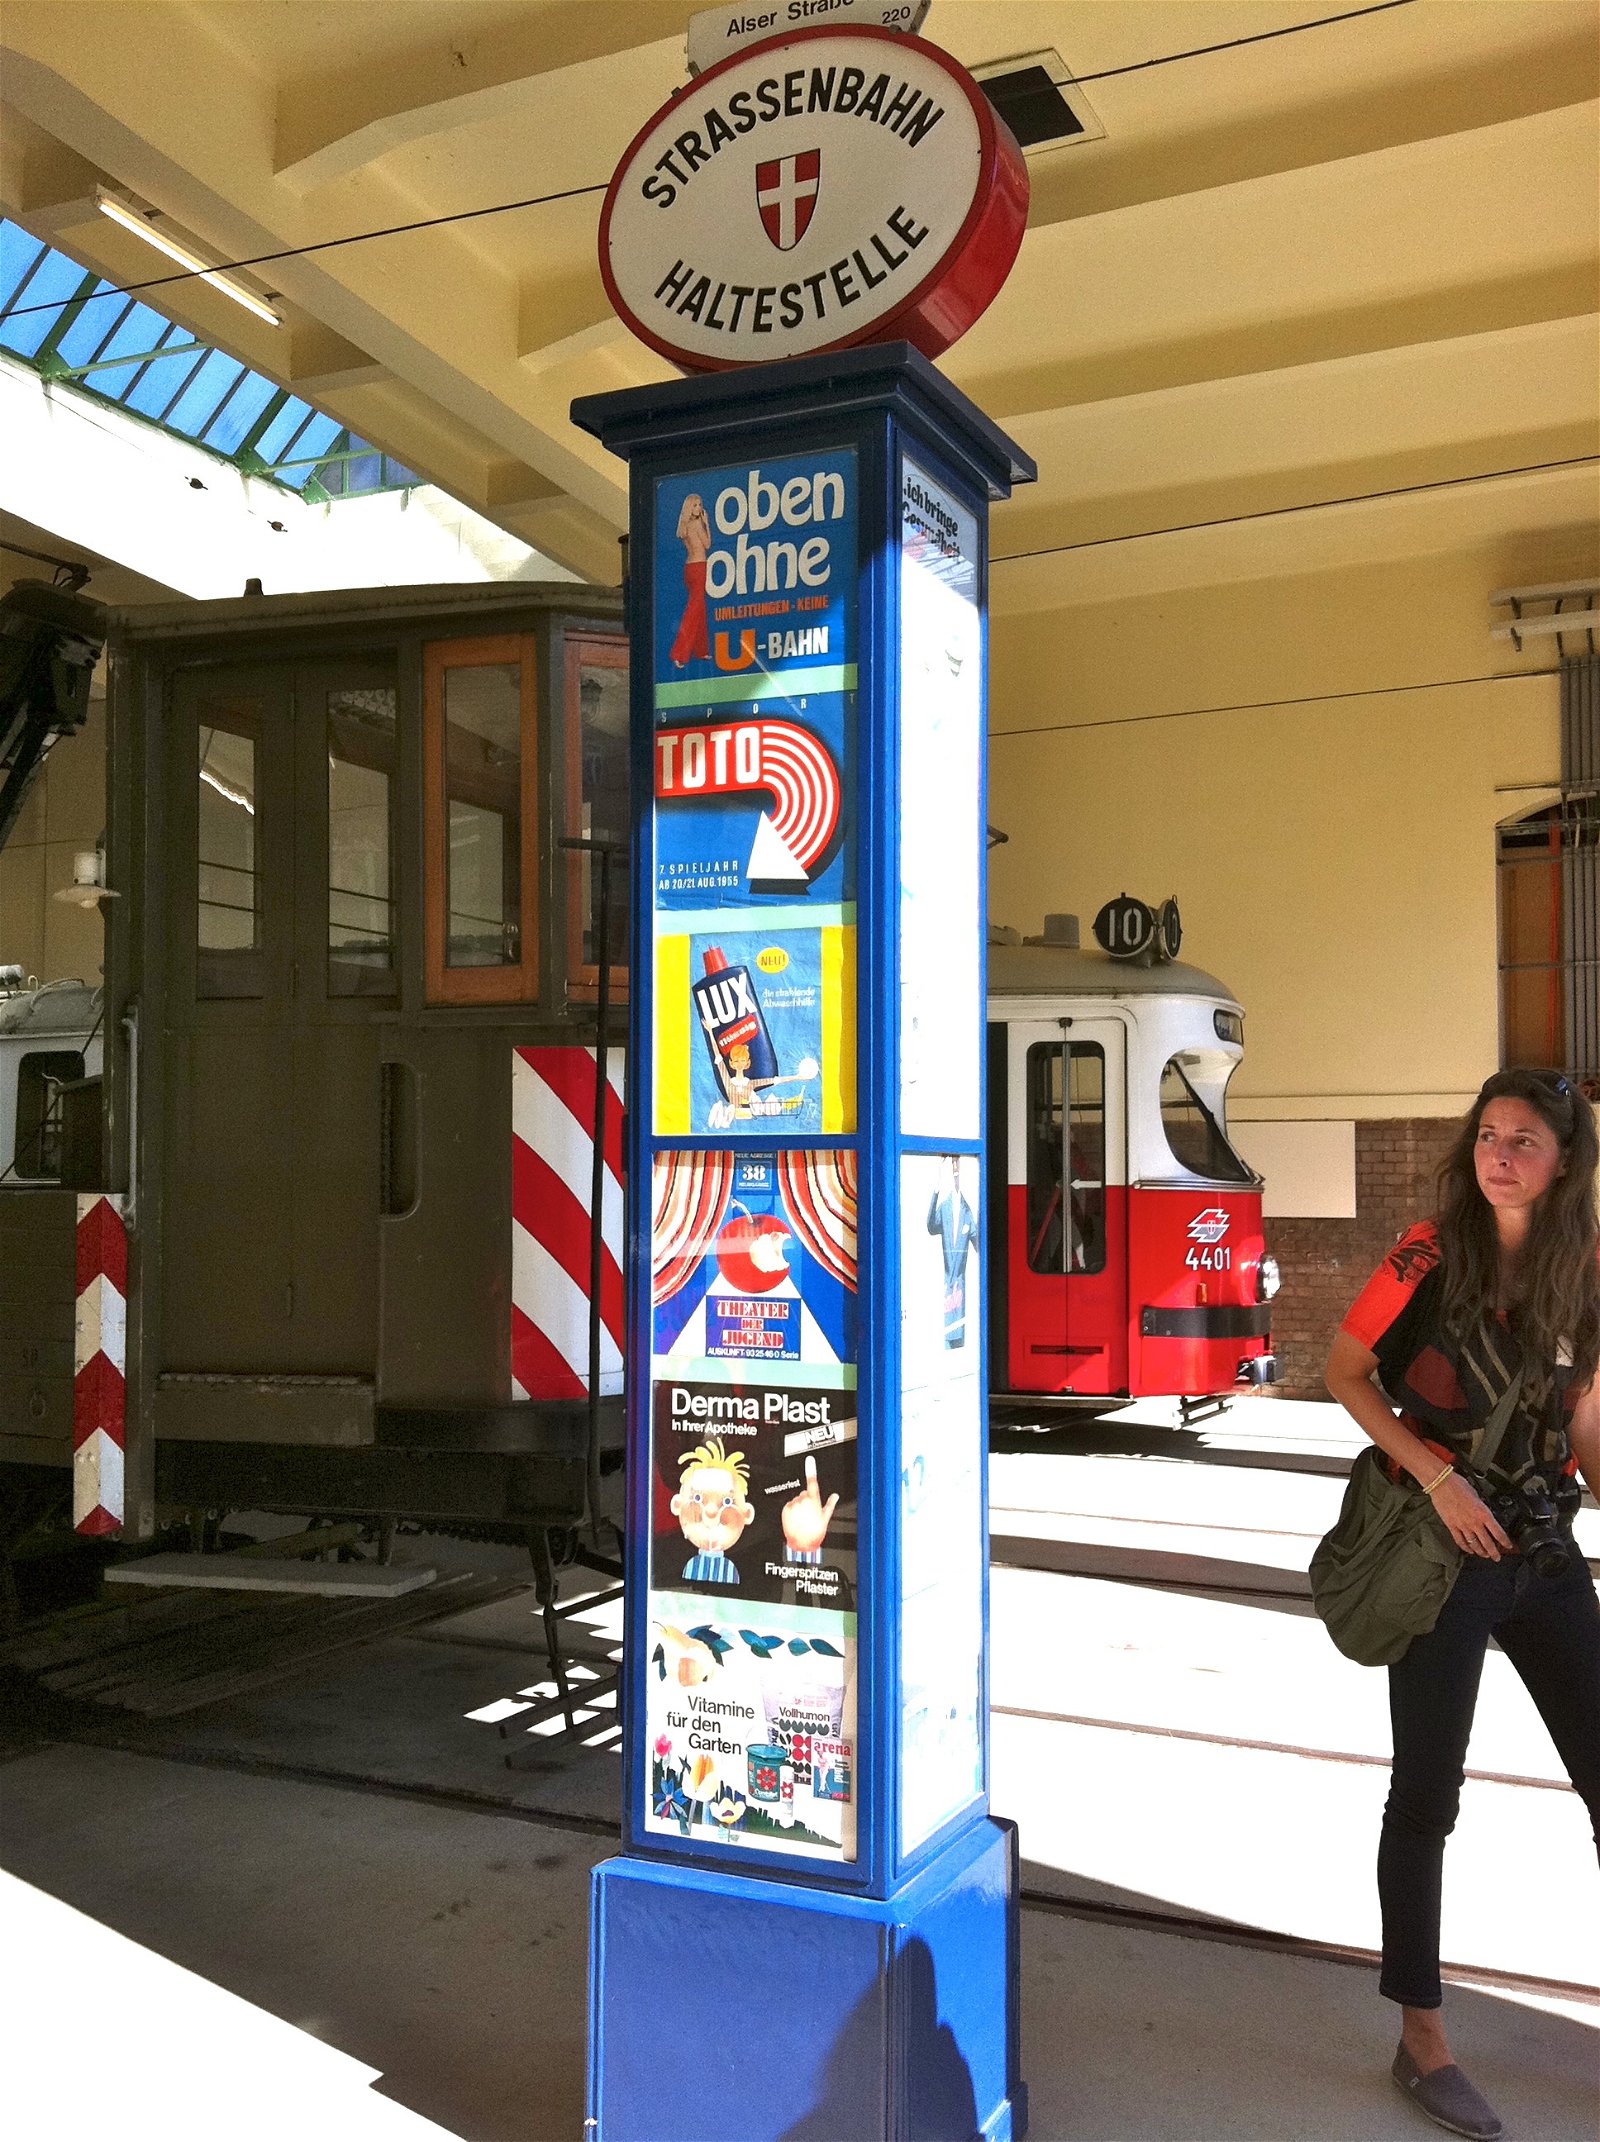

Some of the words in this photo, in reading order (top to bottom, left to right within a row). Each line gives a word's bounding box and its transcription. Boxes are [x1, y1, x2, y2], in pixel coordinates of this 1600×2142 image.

[726, 11, 778, 37] Alser
[881, 6, 911, 24] 220
[642, 66, 945, 209] STRASSENBAHN
[654, 205, 929, 334] HALTESTELLE
[715, 469, 845, 536] oben
[924, 491, 959, 538] bringe
[704, 533, 831, 599] ohne
[657, 727, 761, 790] TOTO
[669, 860, 739, 875] SPIELJAHR
[658, 879, 670, 891] AB
[716, 875, 739, 888] 1955
[1109, 907, 1142, 947] 10
[760, 954, 786, 967] NEU!
[697, 973, 758, 1029] LUX
[742, 1164, 767, 1181] 38
[1185, 1247, 1231, 1271] 4401
[718, 1301, 789, 1317] THEATER
[742, 1319, 763, 1329] DER
[723, 1331, 784, 1347] JUGEND
[671, 1388, 760, 1420] Derma
[764, 1393, 831, 1424] Plast
[671, 1418, 681, 1431] In
[682, 1420, 706, 1433] Ihrer
[705, 1421, 758, 1436] Apotheke
[805, 1424, 835, 1446] NEU
[765, 1562, 839, 1582] Fingerspitzen
[795, 1580, 839, 1596] Pflaster
[687, 1695, 755, 1720] Vitamine
[666, 1711, 688, 1728] für
[692, 1715, 721, 1734] den
[688, 1733, 742, 1755] Garten
[813, 1741, 851, 1757] arena
